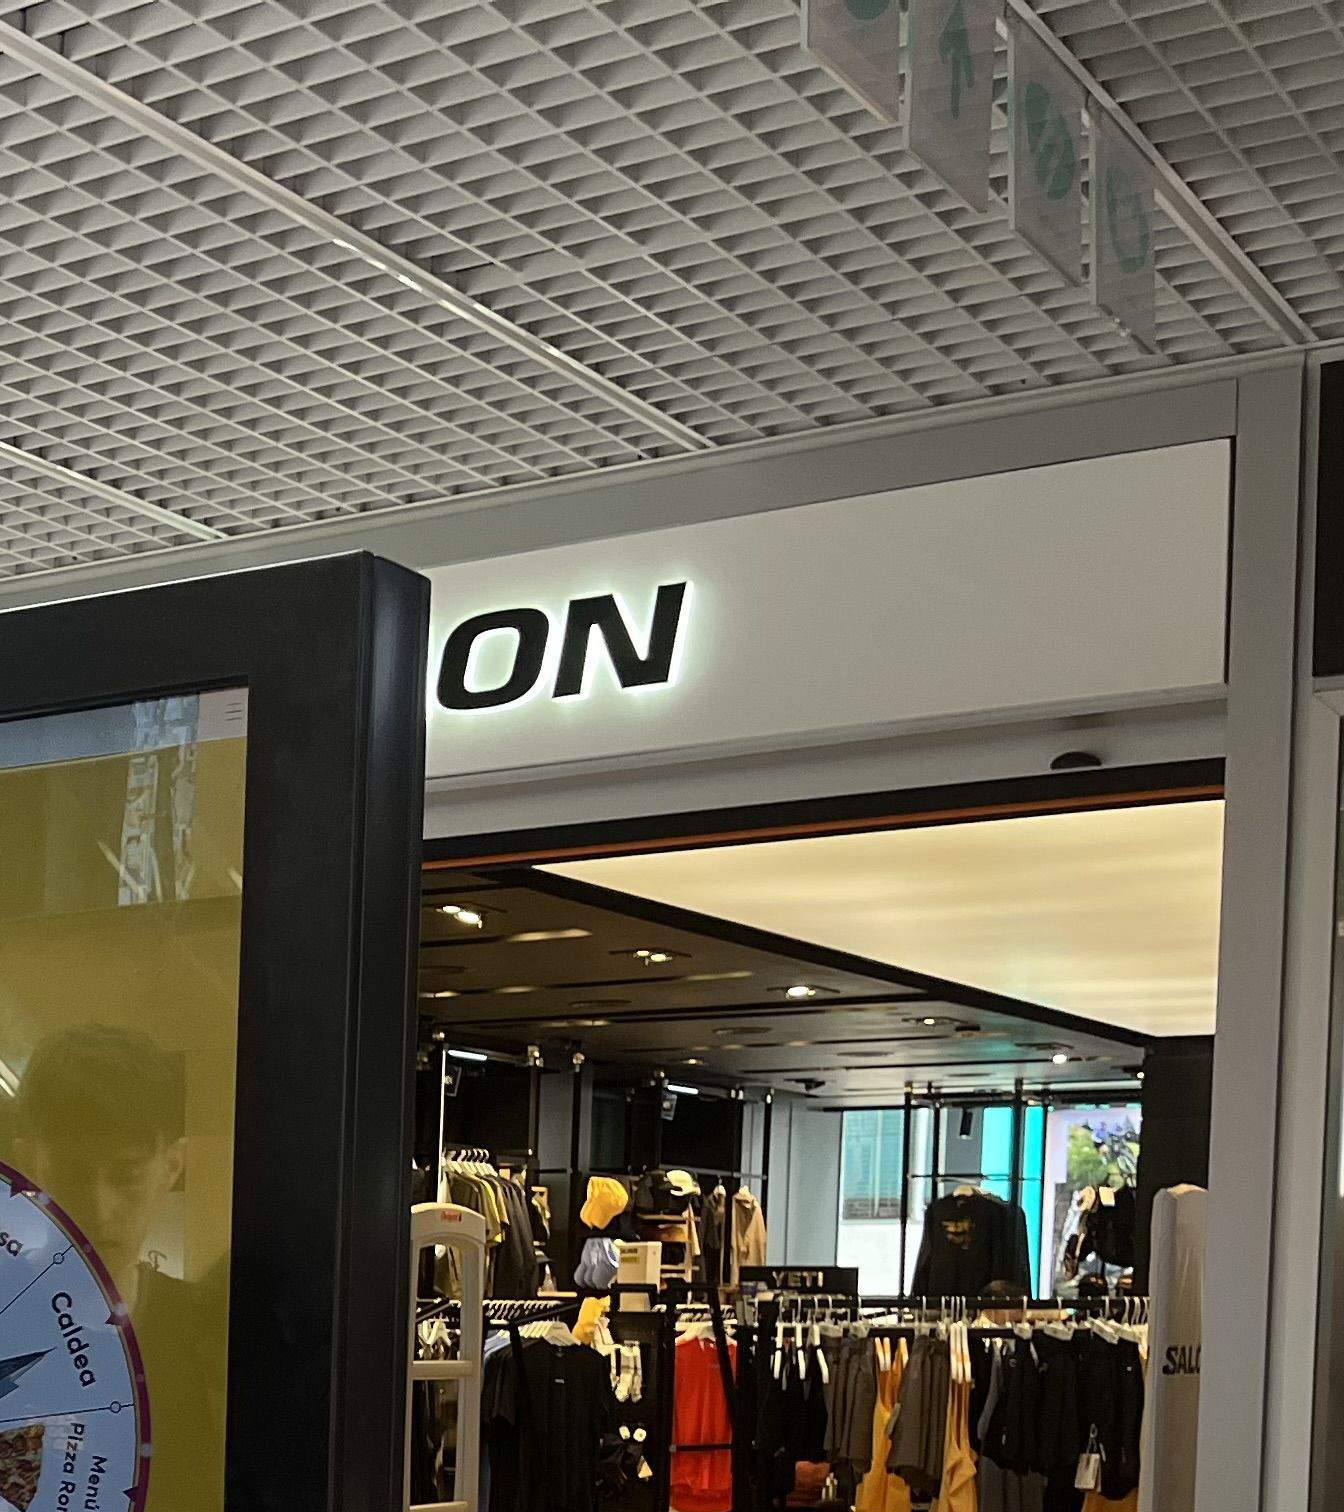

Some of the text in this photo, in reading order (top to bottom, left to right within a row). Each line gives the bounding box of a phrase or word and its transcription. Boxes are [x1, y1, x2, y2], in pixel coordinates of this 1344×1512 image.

[436, 579, 688, 712] ON
[771, 1271, 824, 1288] YETI
[51, 1291, 97, 1387] Caldea
[63, 1422, 86, 1474] Pizza
[84, 1455, 109, 1512] Menú
